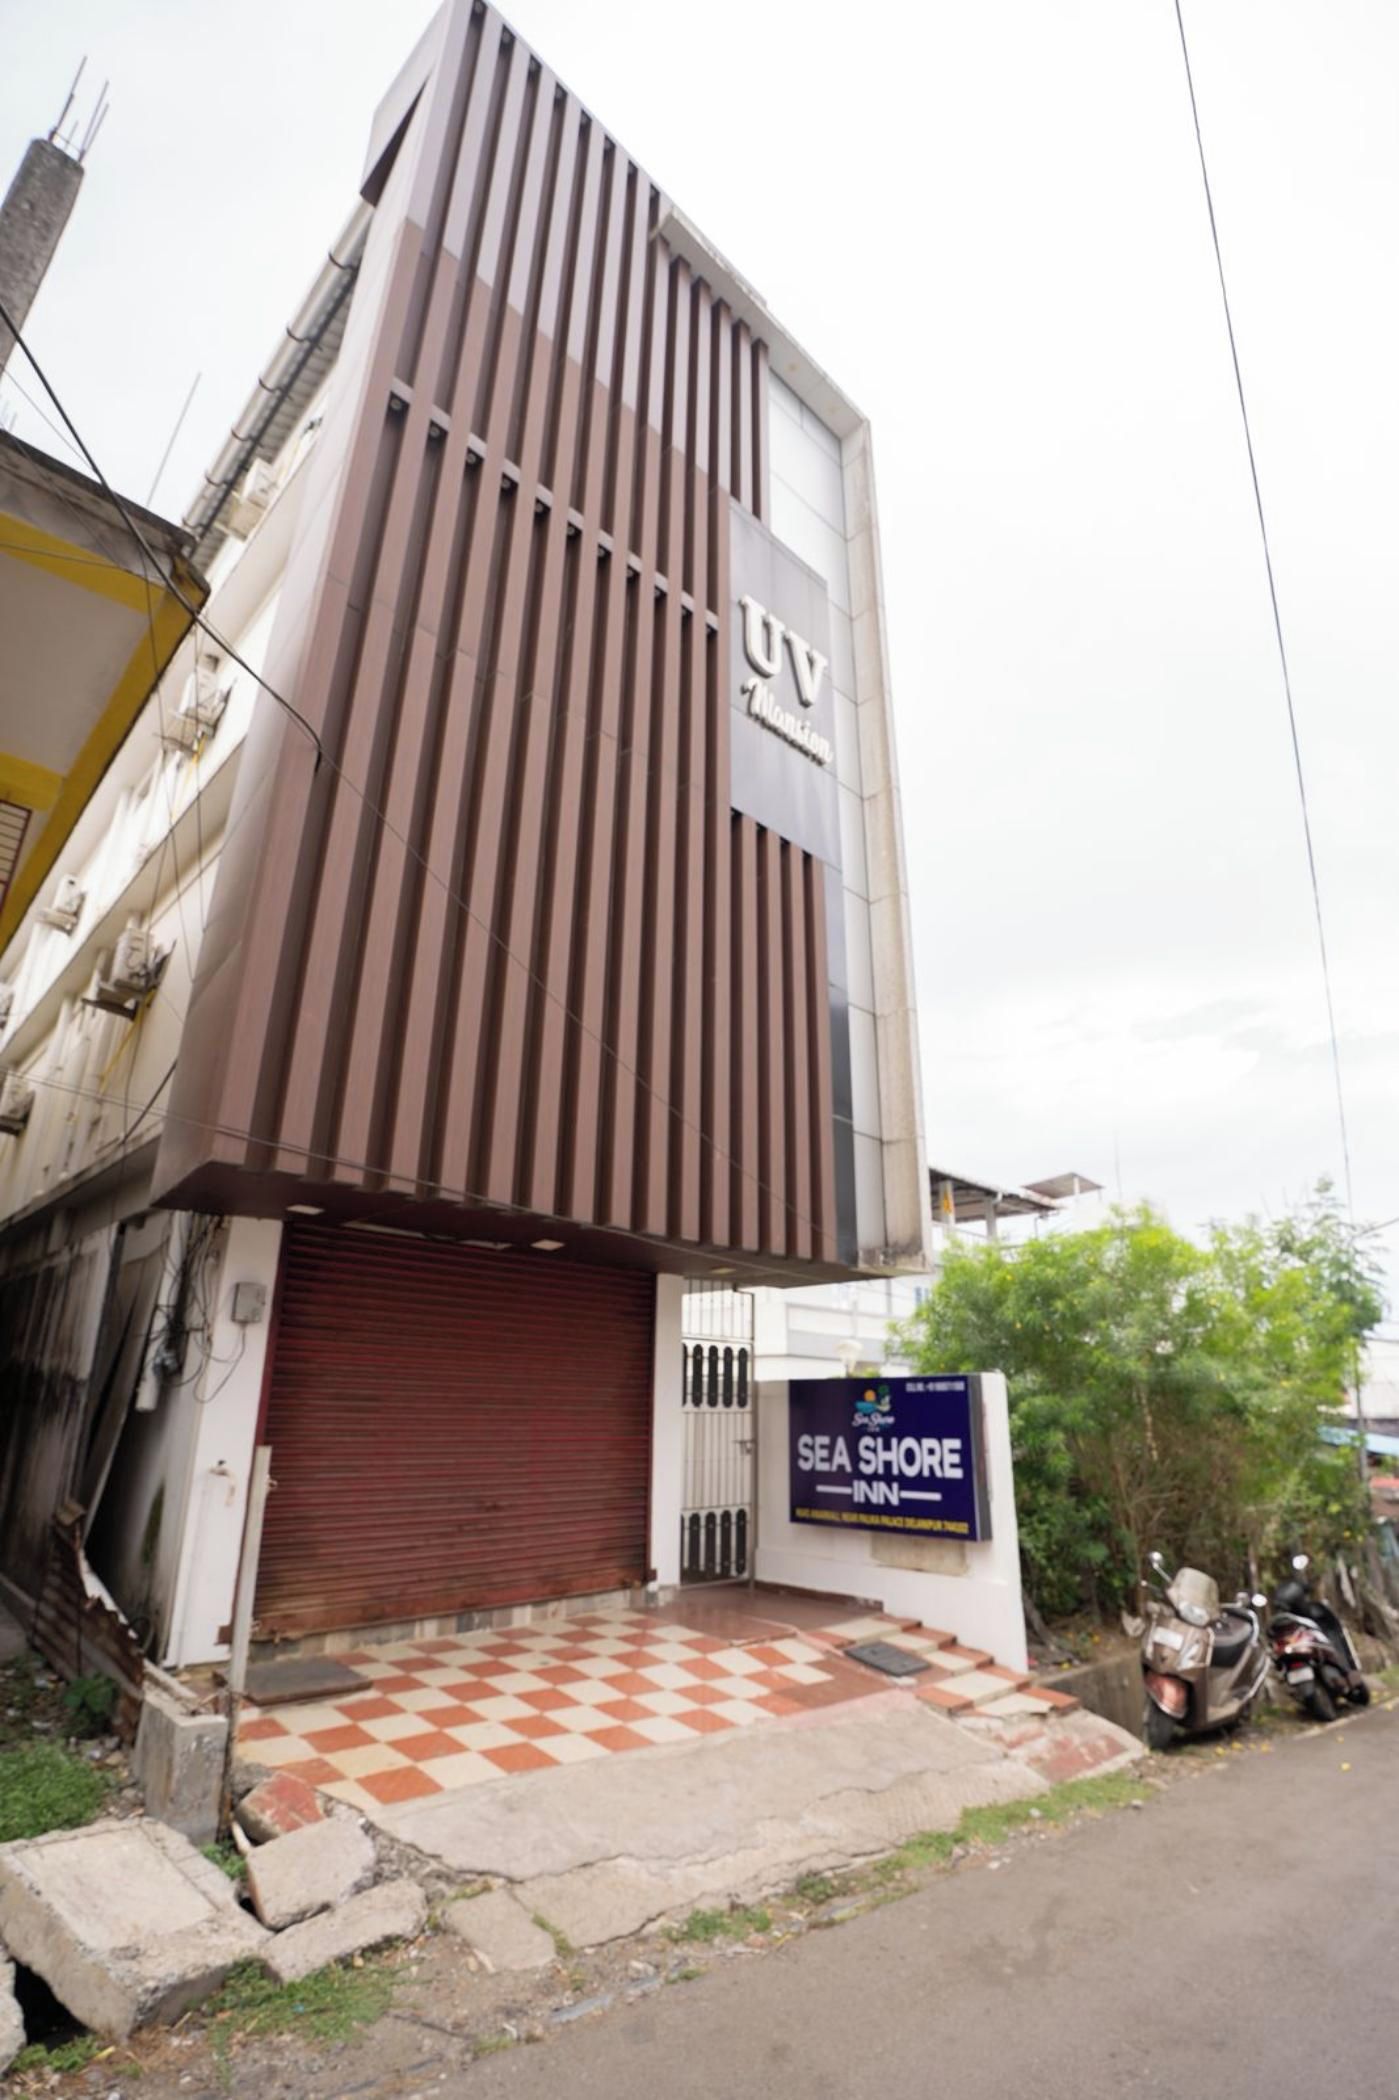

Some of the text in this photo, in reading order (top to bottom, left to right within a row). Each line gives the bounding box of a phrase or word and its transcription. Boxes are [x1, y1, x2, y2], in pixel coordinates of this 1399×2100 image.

[738, 595, 827, 707] UV
[797, 1433, 964, 1479] SEA SHORE
[852, 1480, 900, 1506] INN
